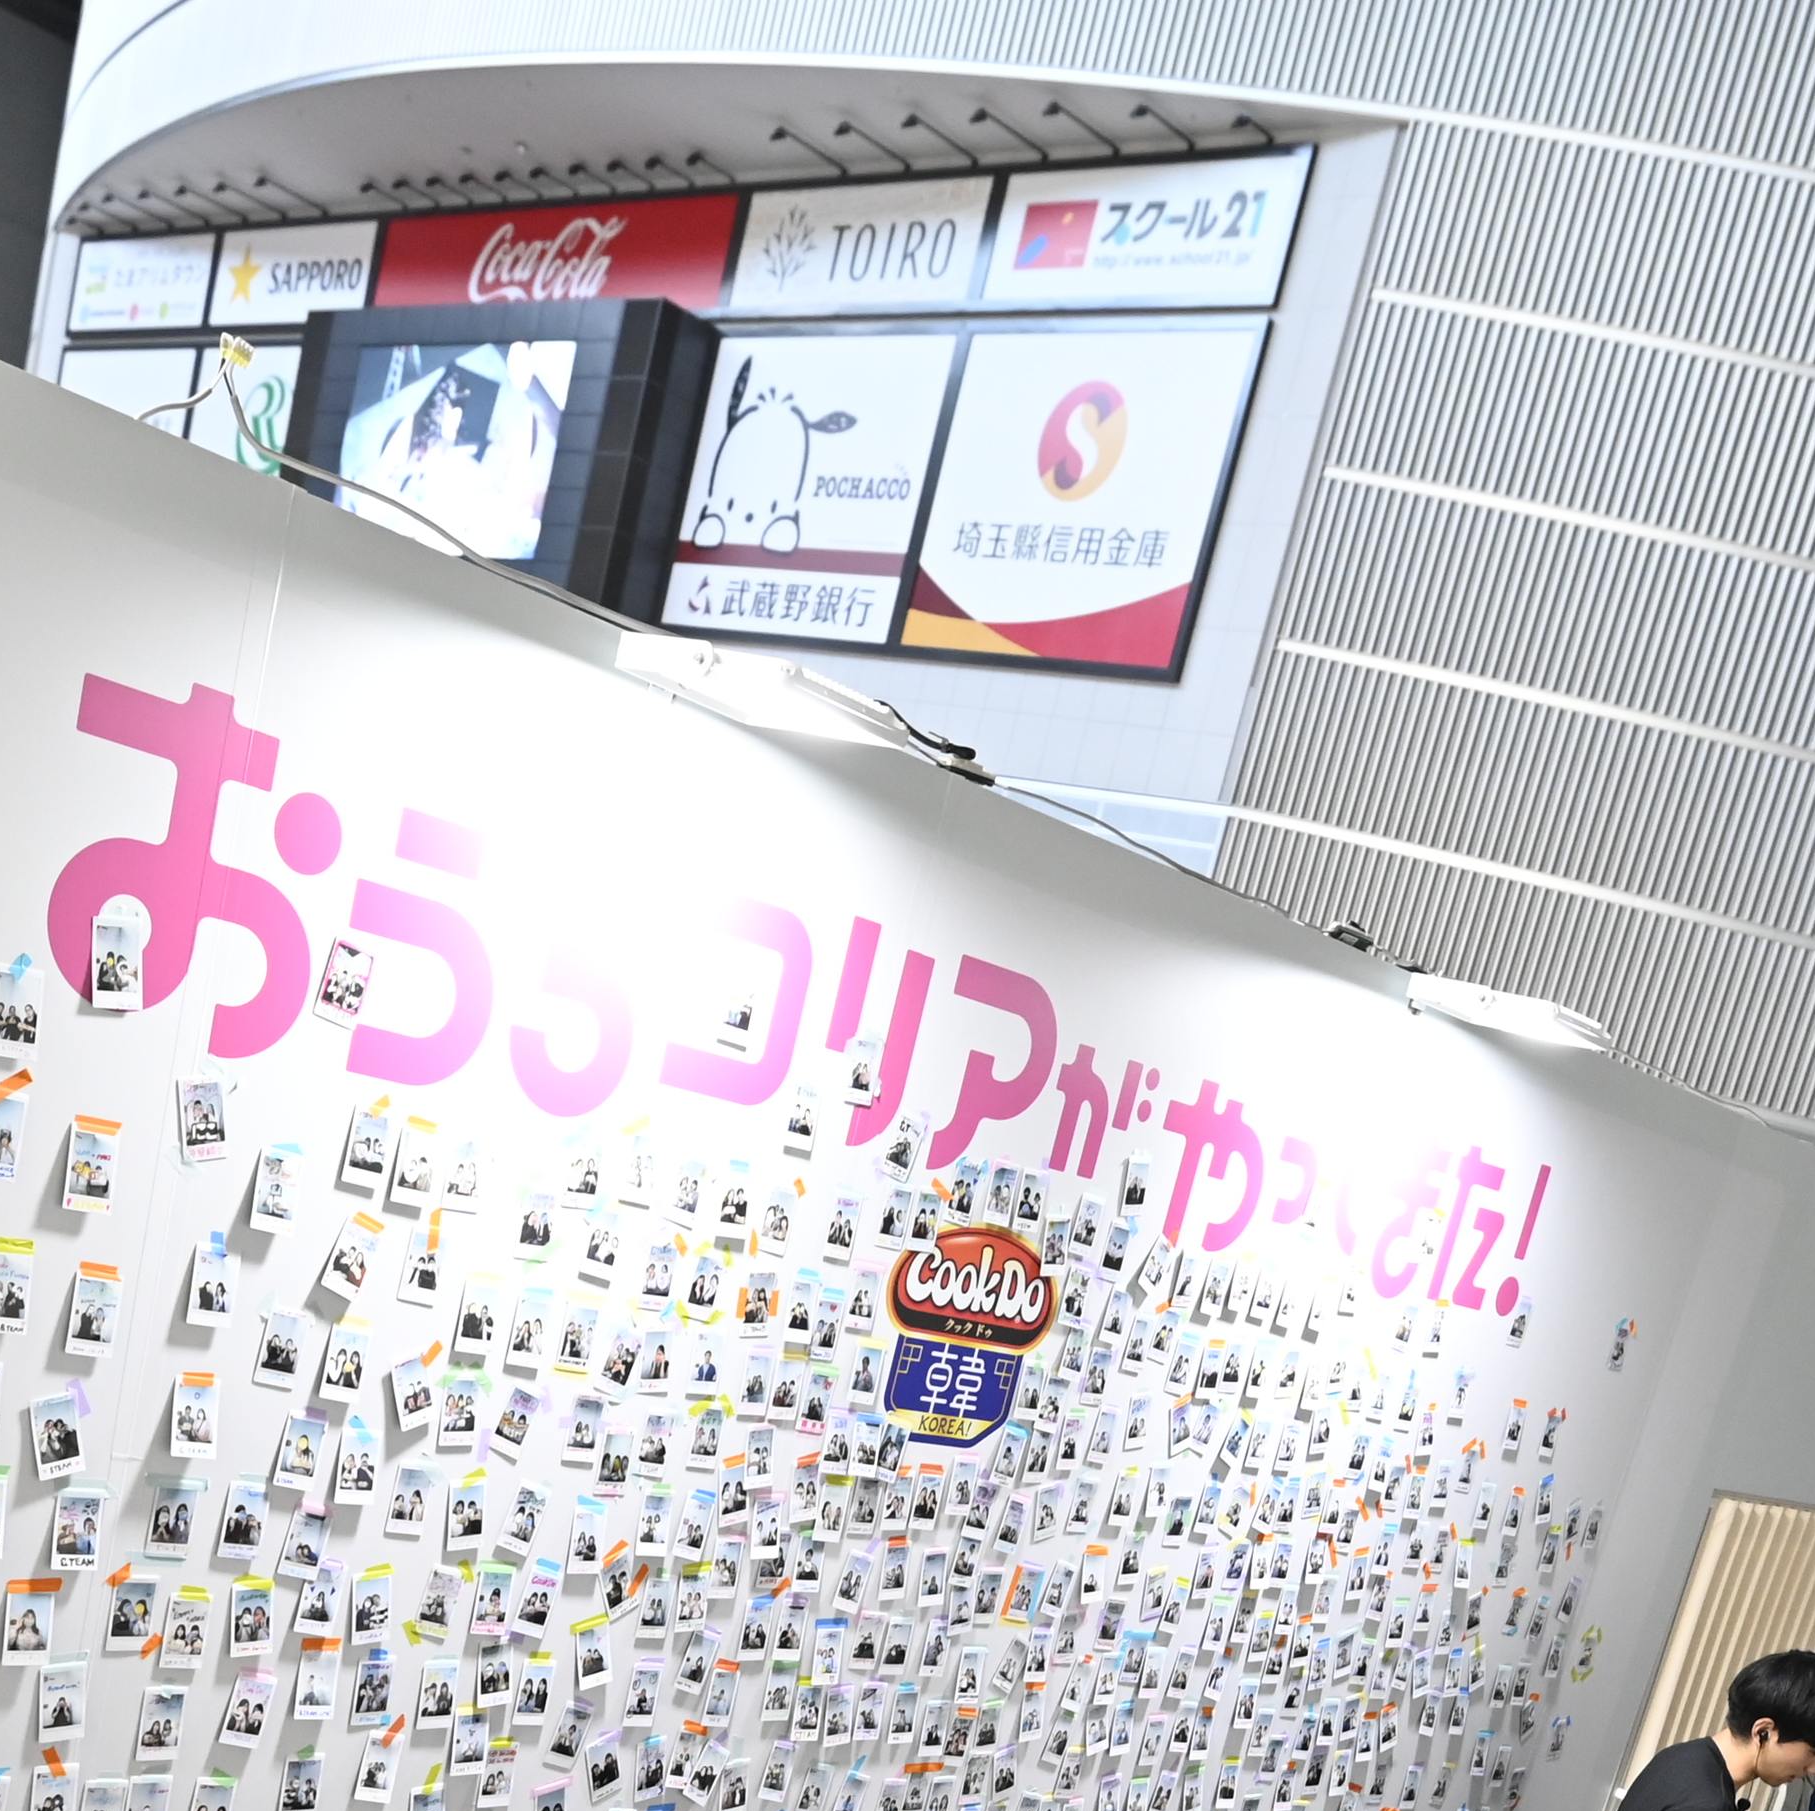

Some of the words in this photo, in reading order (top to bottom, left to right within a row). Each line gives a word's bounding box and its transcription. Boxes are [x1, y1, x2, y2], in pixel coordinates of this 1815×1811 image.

[1101, 190, 1267, 245] スクール21
[829, 218, 957, 284] TOIRO
[268, 258, 363, 295] SAPPORO
[814, 476, 910, 502] POCHACCO
[952, 522, 1170, 569] 埼玉縣信用金庫
[721, 579, 876, 628] 武蔵野銀行
[919, 1342, 987, 1417] 韓
[918, 1415, 973, 1438] KOREA!
[59, 1557, 96, 1568] &TEAM
